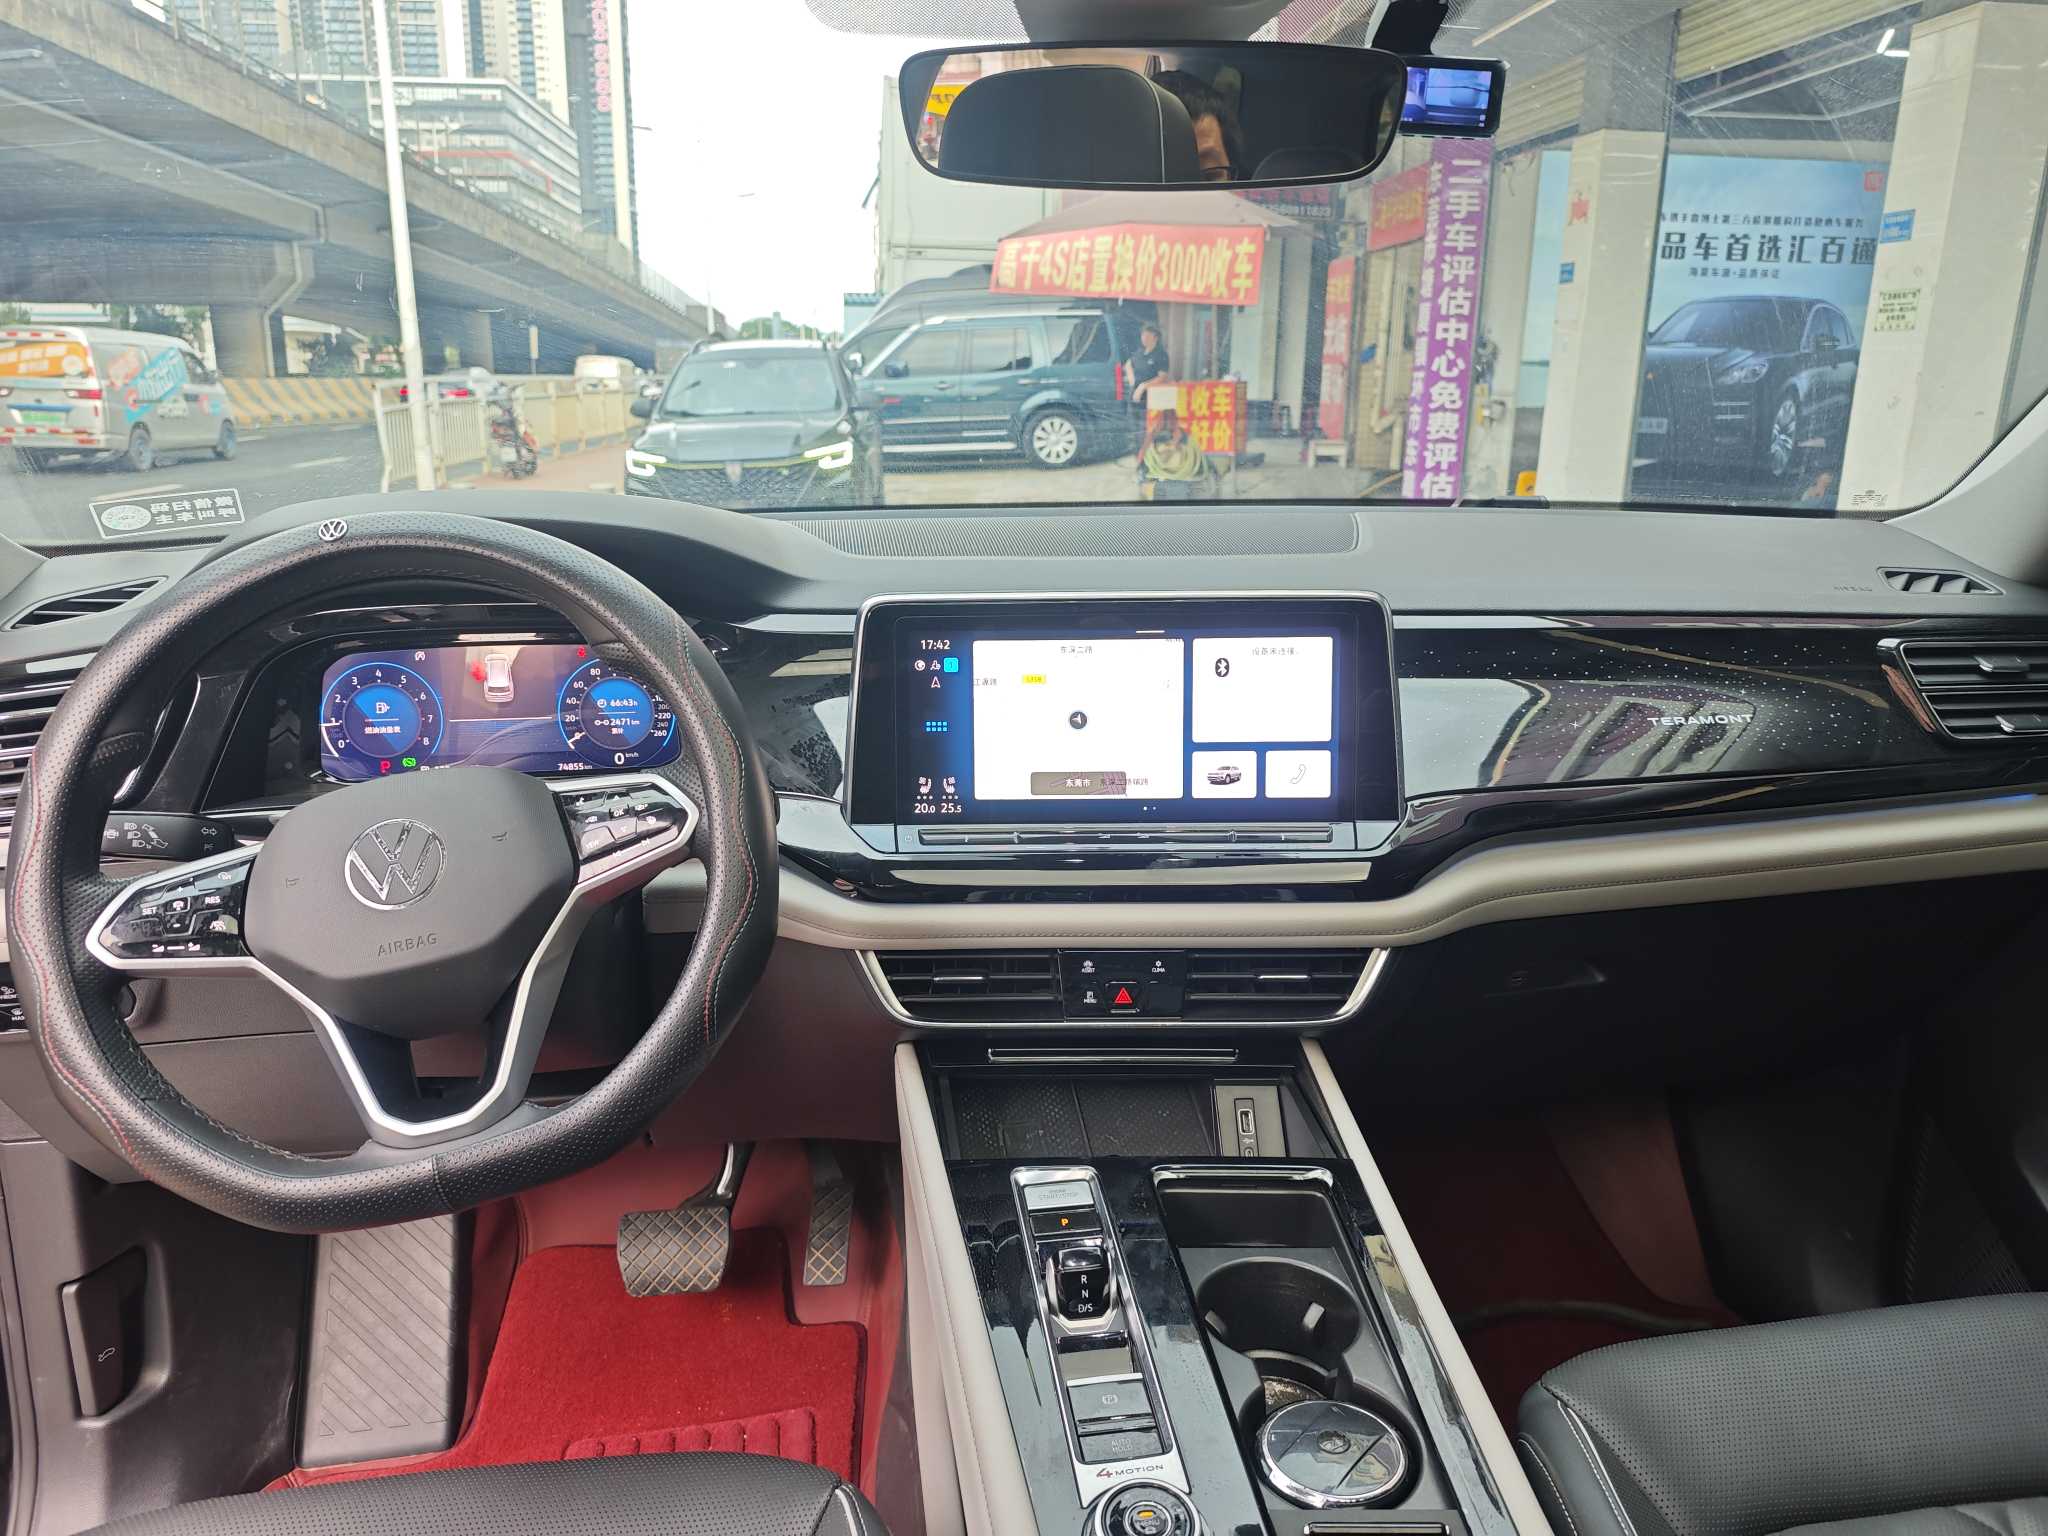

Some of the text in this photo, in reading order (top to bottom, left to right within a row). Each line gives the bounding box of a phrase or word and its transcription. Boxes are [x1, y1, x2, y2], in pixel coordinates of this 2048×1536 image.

[997, 233, 1256, 299] 高于4S店置换价3000收车
[921, 640, 950, 650] 17:42
[375, 669, 381, 677] 4
[352, 677, 358, 685] 3
[428, 715, 433, 723] 7
[1647, 714, 1754, 726] TERAMONT
[338, 740, 345, 748] 0
[423, 737, 429, 745] 8
[614, 753, 625, 764] 0
[614, 808, 624, 816] OK
[914, 803, 936, 813] 20.0
[941, 803, 962, 813] 25.5
[205, 896, 221, 904] RES
[142, 907, 157, 915] SET
[378, 932, 438, 956] AIRBAG
[1061, 1218, 1069, 1226] P
[1081, 1275, 1087, 1284] R
[1081, 1289, 1089, 1298] N
[1078, 1303, 1093, 1313] D/S
[1111, 1438, 1132, 1447] AUTO
[1096, 1463, 1164, 1478] 4MOTION
